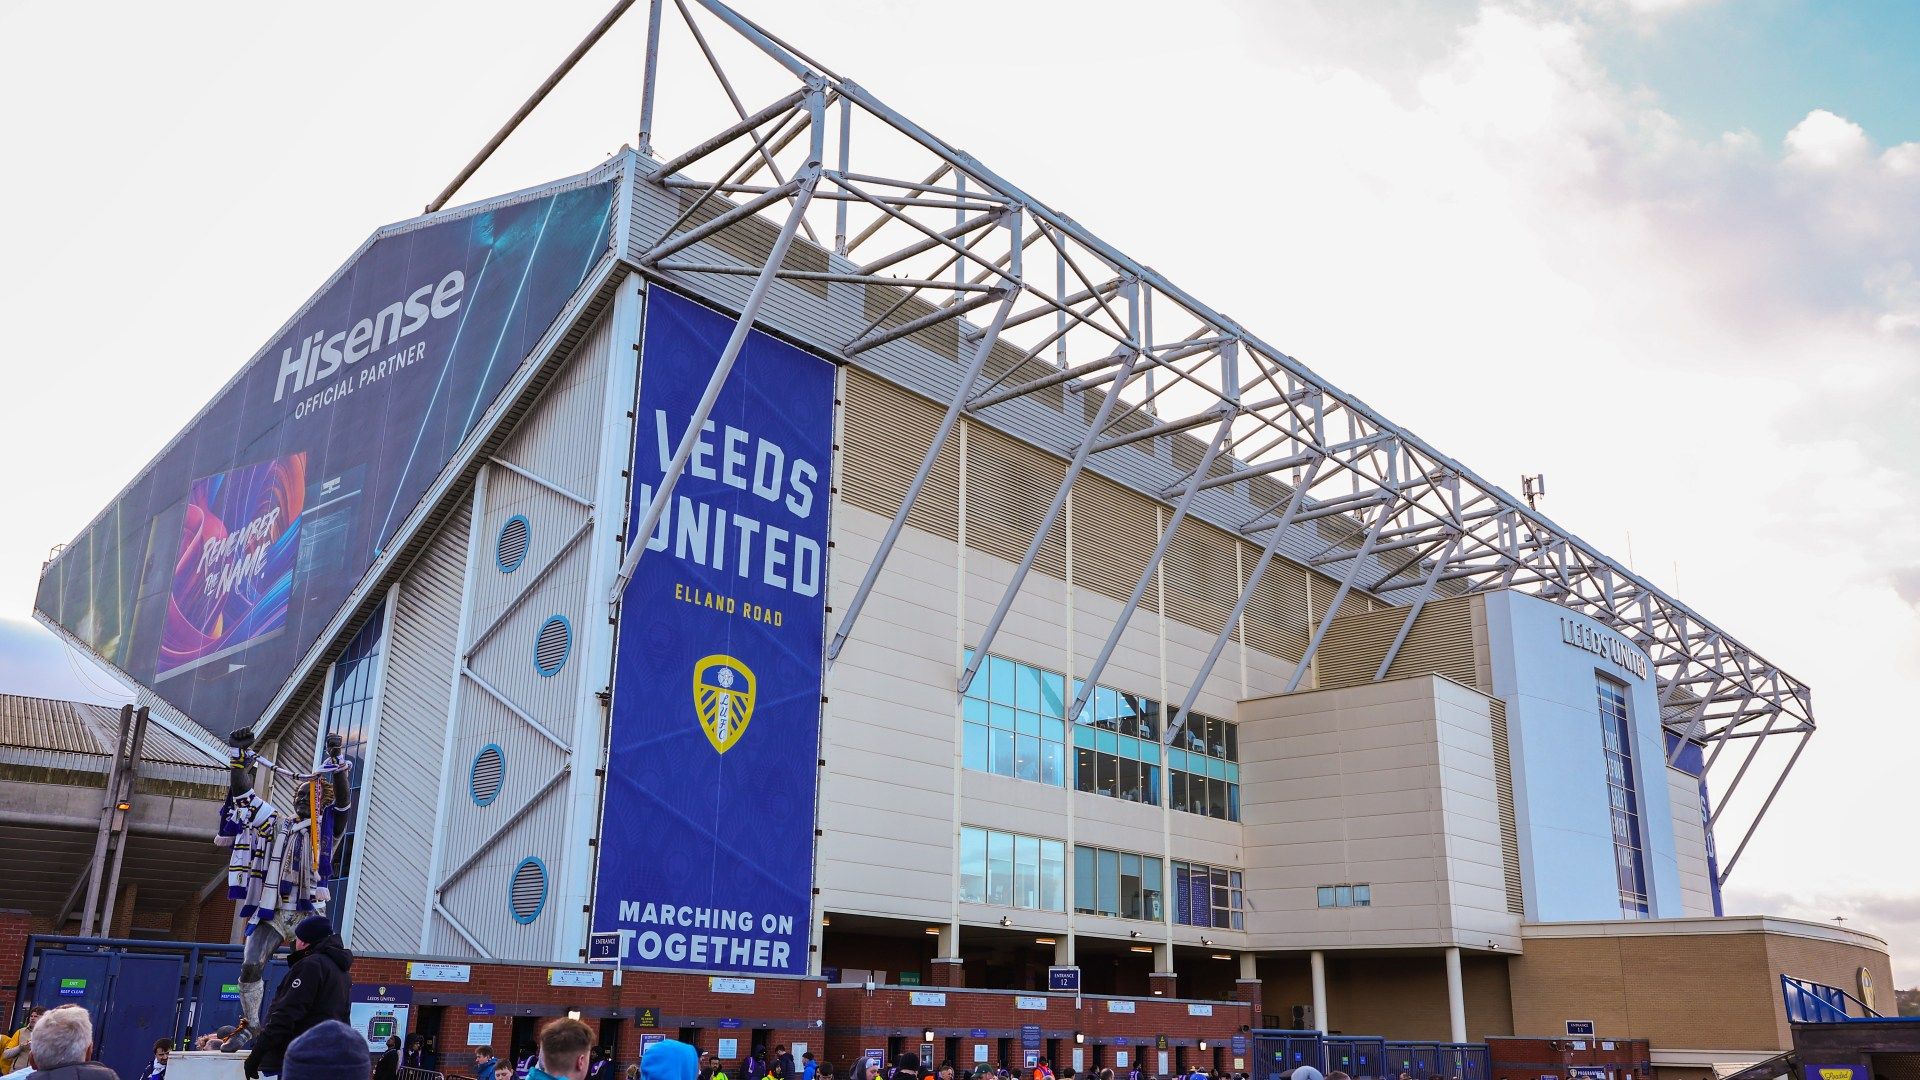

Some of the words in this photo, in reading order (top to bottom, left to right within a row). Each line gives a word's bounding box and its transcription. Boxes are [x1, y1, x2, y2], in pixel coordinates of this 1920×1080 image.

[273, 270, 465, 403] Hisense
[294, 376, 354, 420] OFFICIAL
[359, 341, 426, 389] PARTNER
[656, 409, 818, 519] LEEDS
[196, 506, 280, 578] REMEMBER
[637, 483, 821, 598] UNITED
[674, 583, 736, 614] ELLAND
[743, 602, 784, 628] ROAD
[1560, 617, 1608, 659] LEEDS
[1608, 637, 1647, 680] UNITED
[601, 945, 609, 955] 13
[617, 928, 791, 968] TOGETHER
[618, 900, 753, 932] MARCHING
[761, 913, 793, 935] ON
